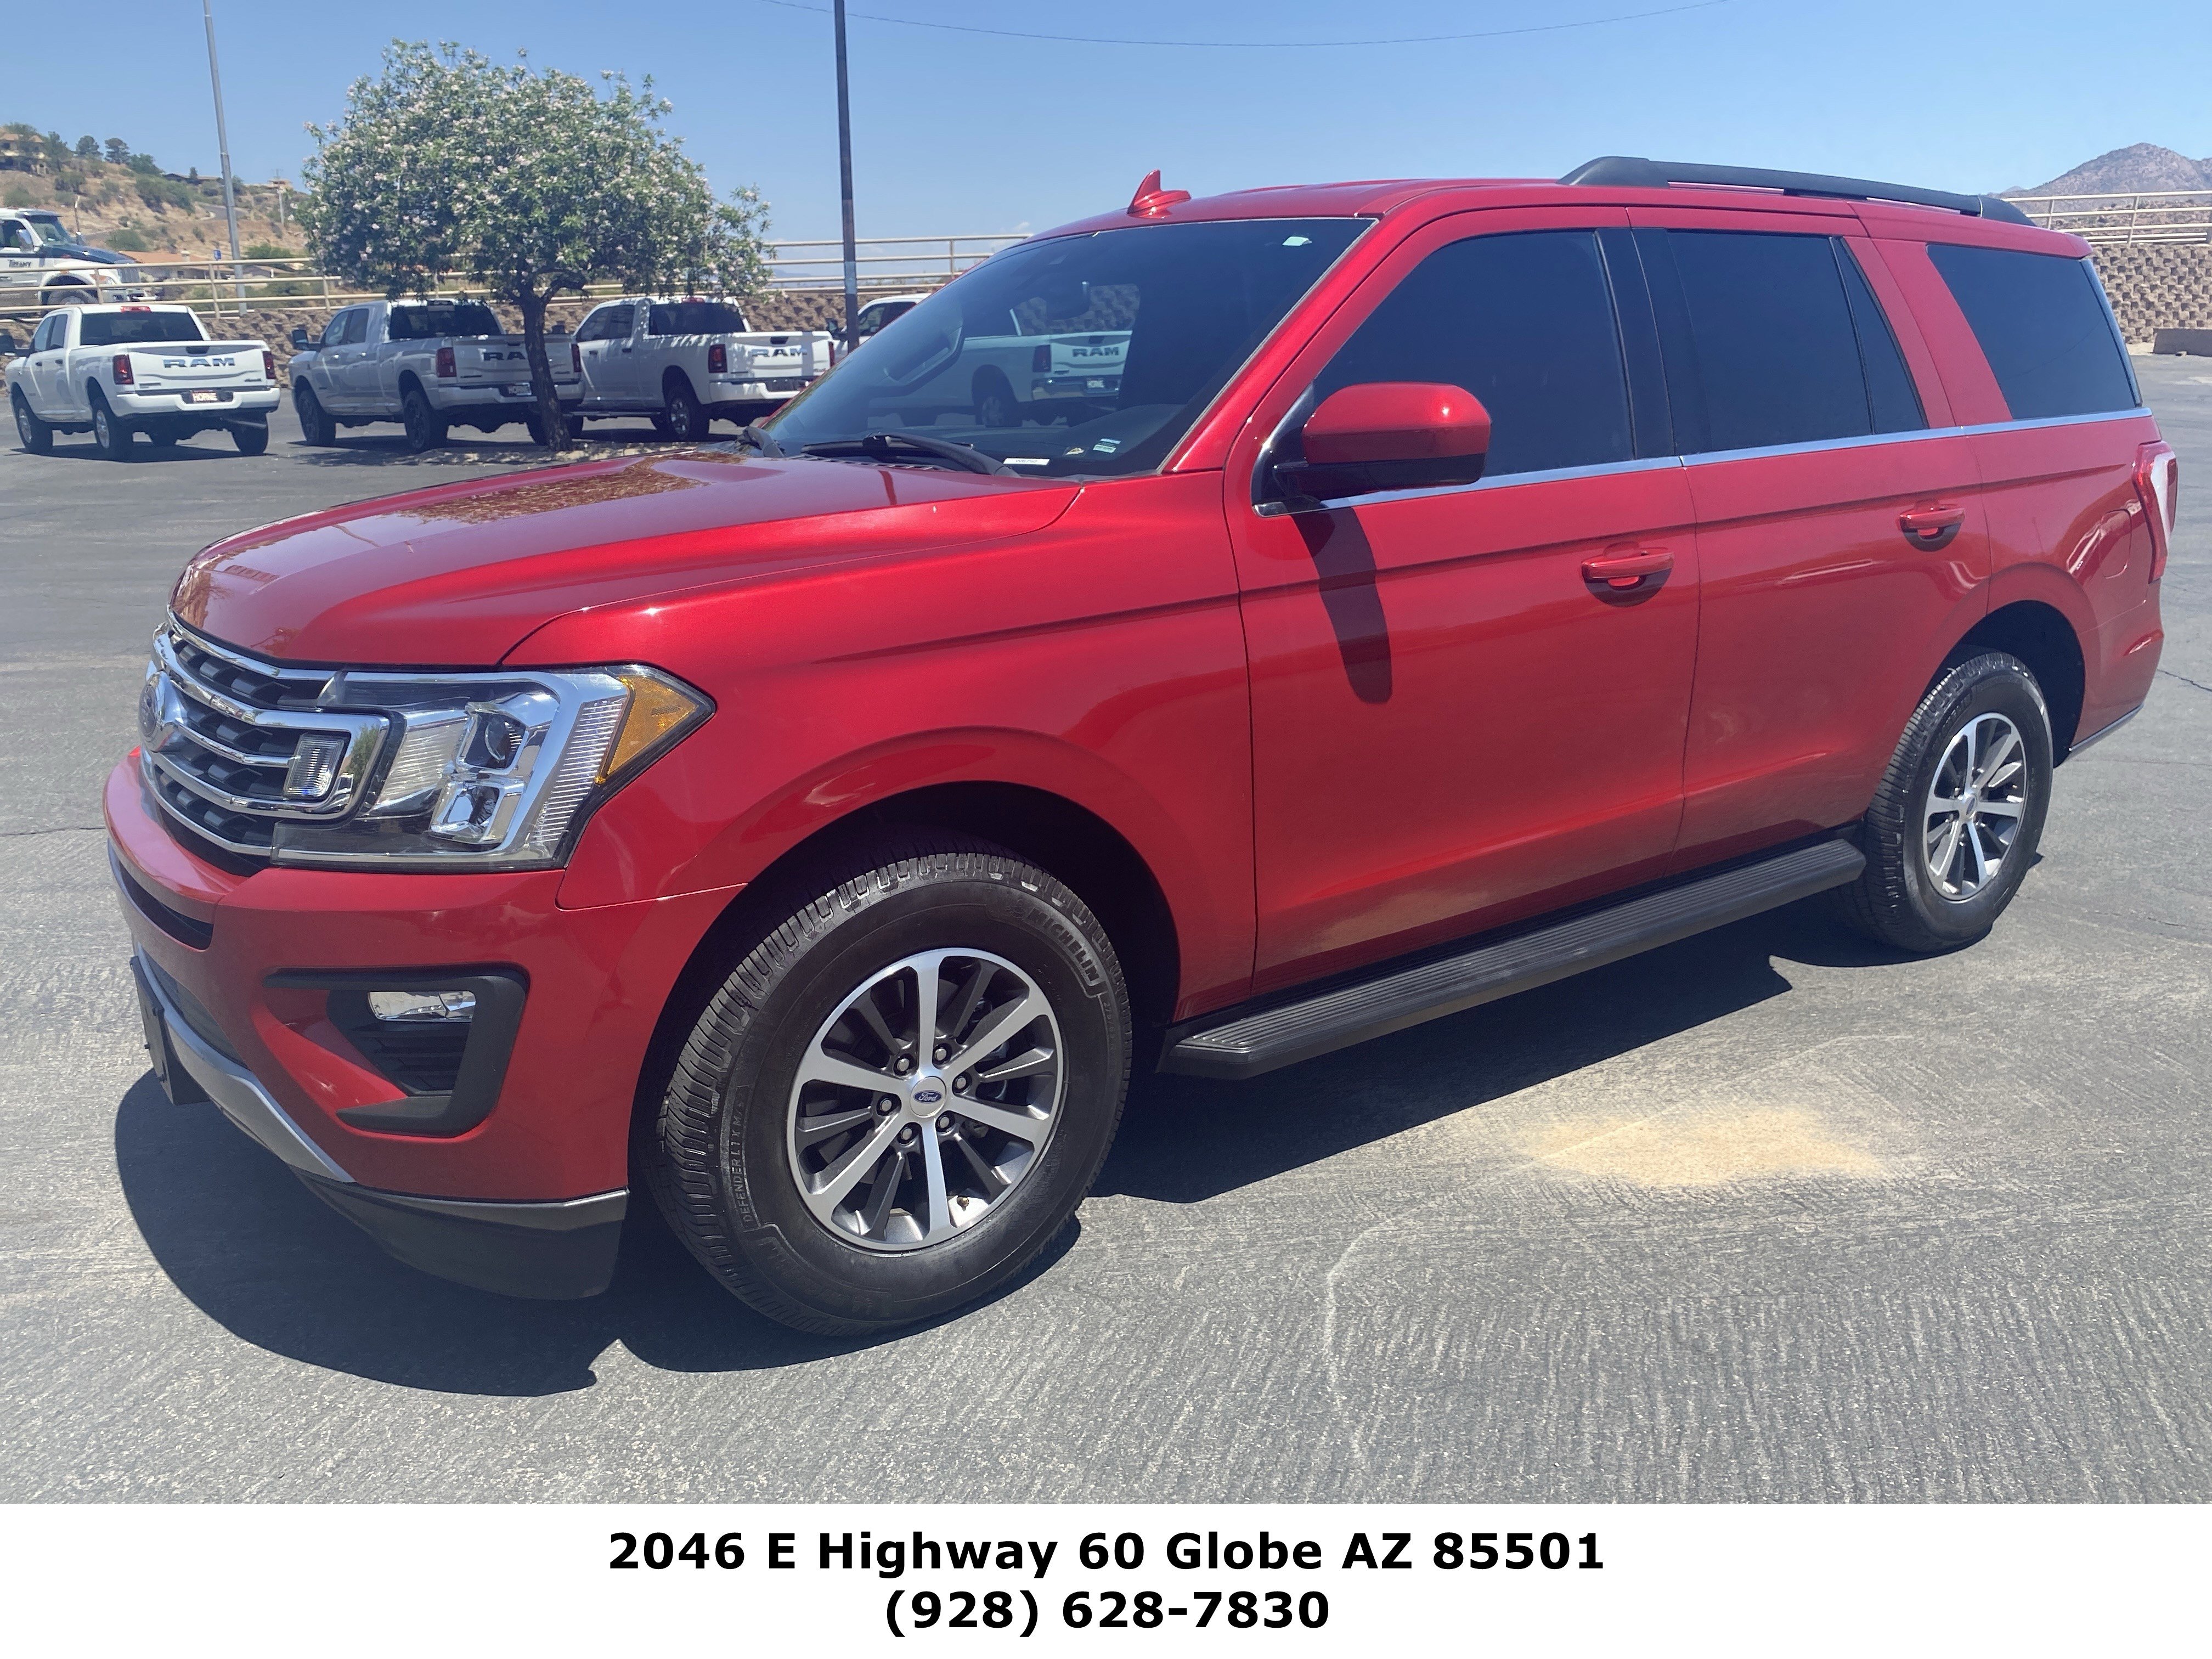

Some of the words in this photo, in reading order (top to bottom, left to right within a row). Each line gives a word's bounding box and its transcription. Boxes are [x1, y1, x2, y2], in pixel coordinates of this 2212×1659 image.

[483, 352, 527, 361] RA
[750, 348, 808, 357] RAM
[1072, 347, 1120, 357] RAM
[163, 358, 235, 368] RAM
[1024, 907, 1101, 983] MICHELIN
[918, 1092, 938, 1102] Ford
[731, 1159, 753, 1223] DEFENDER
